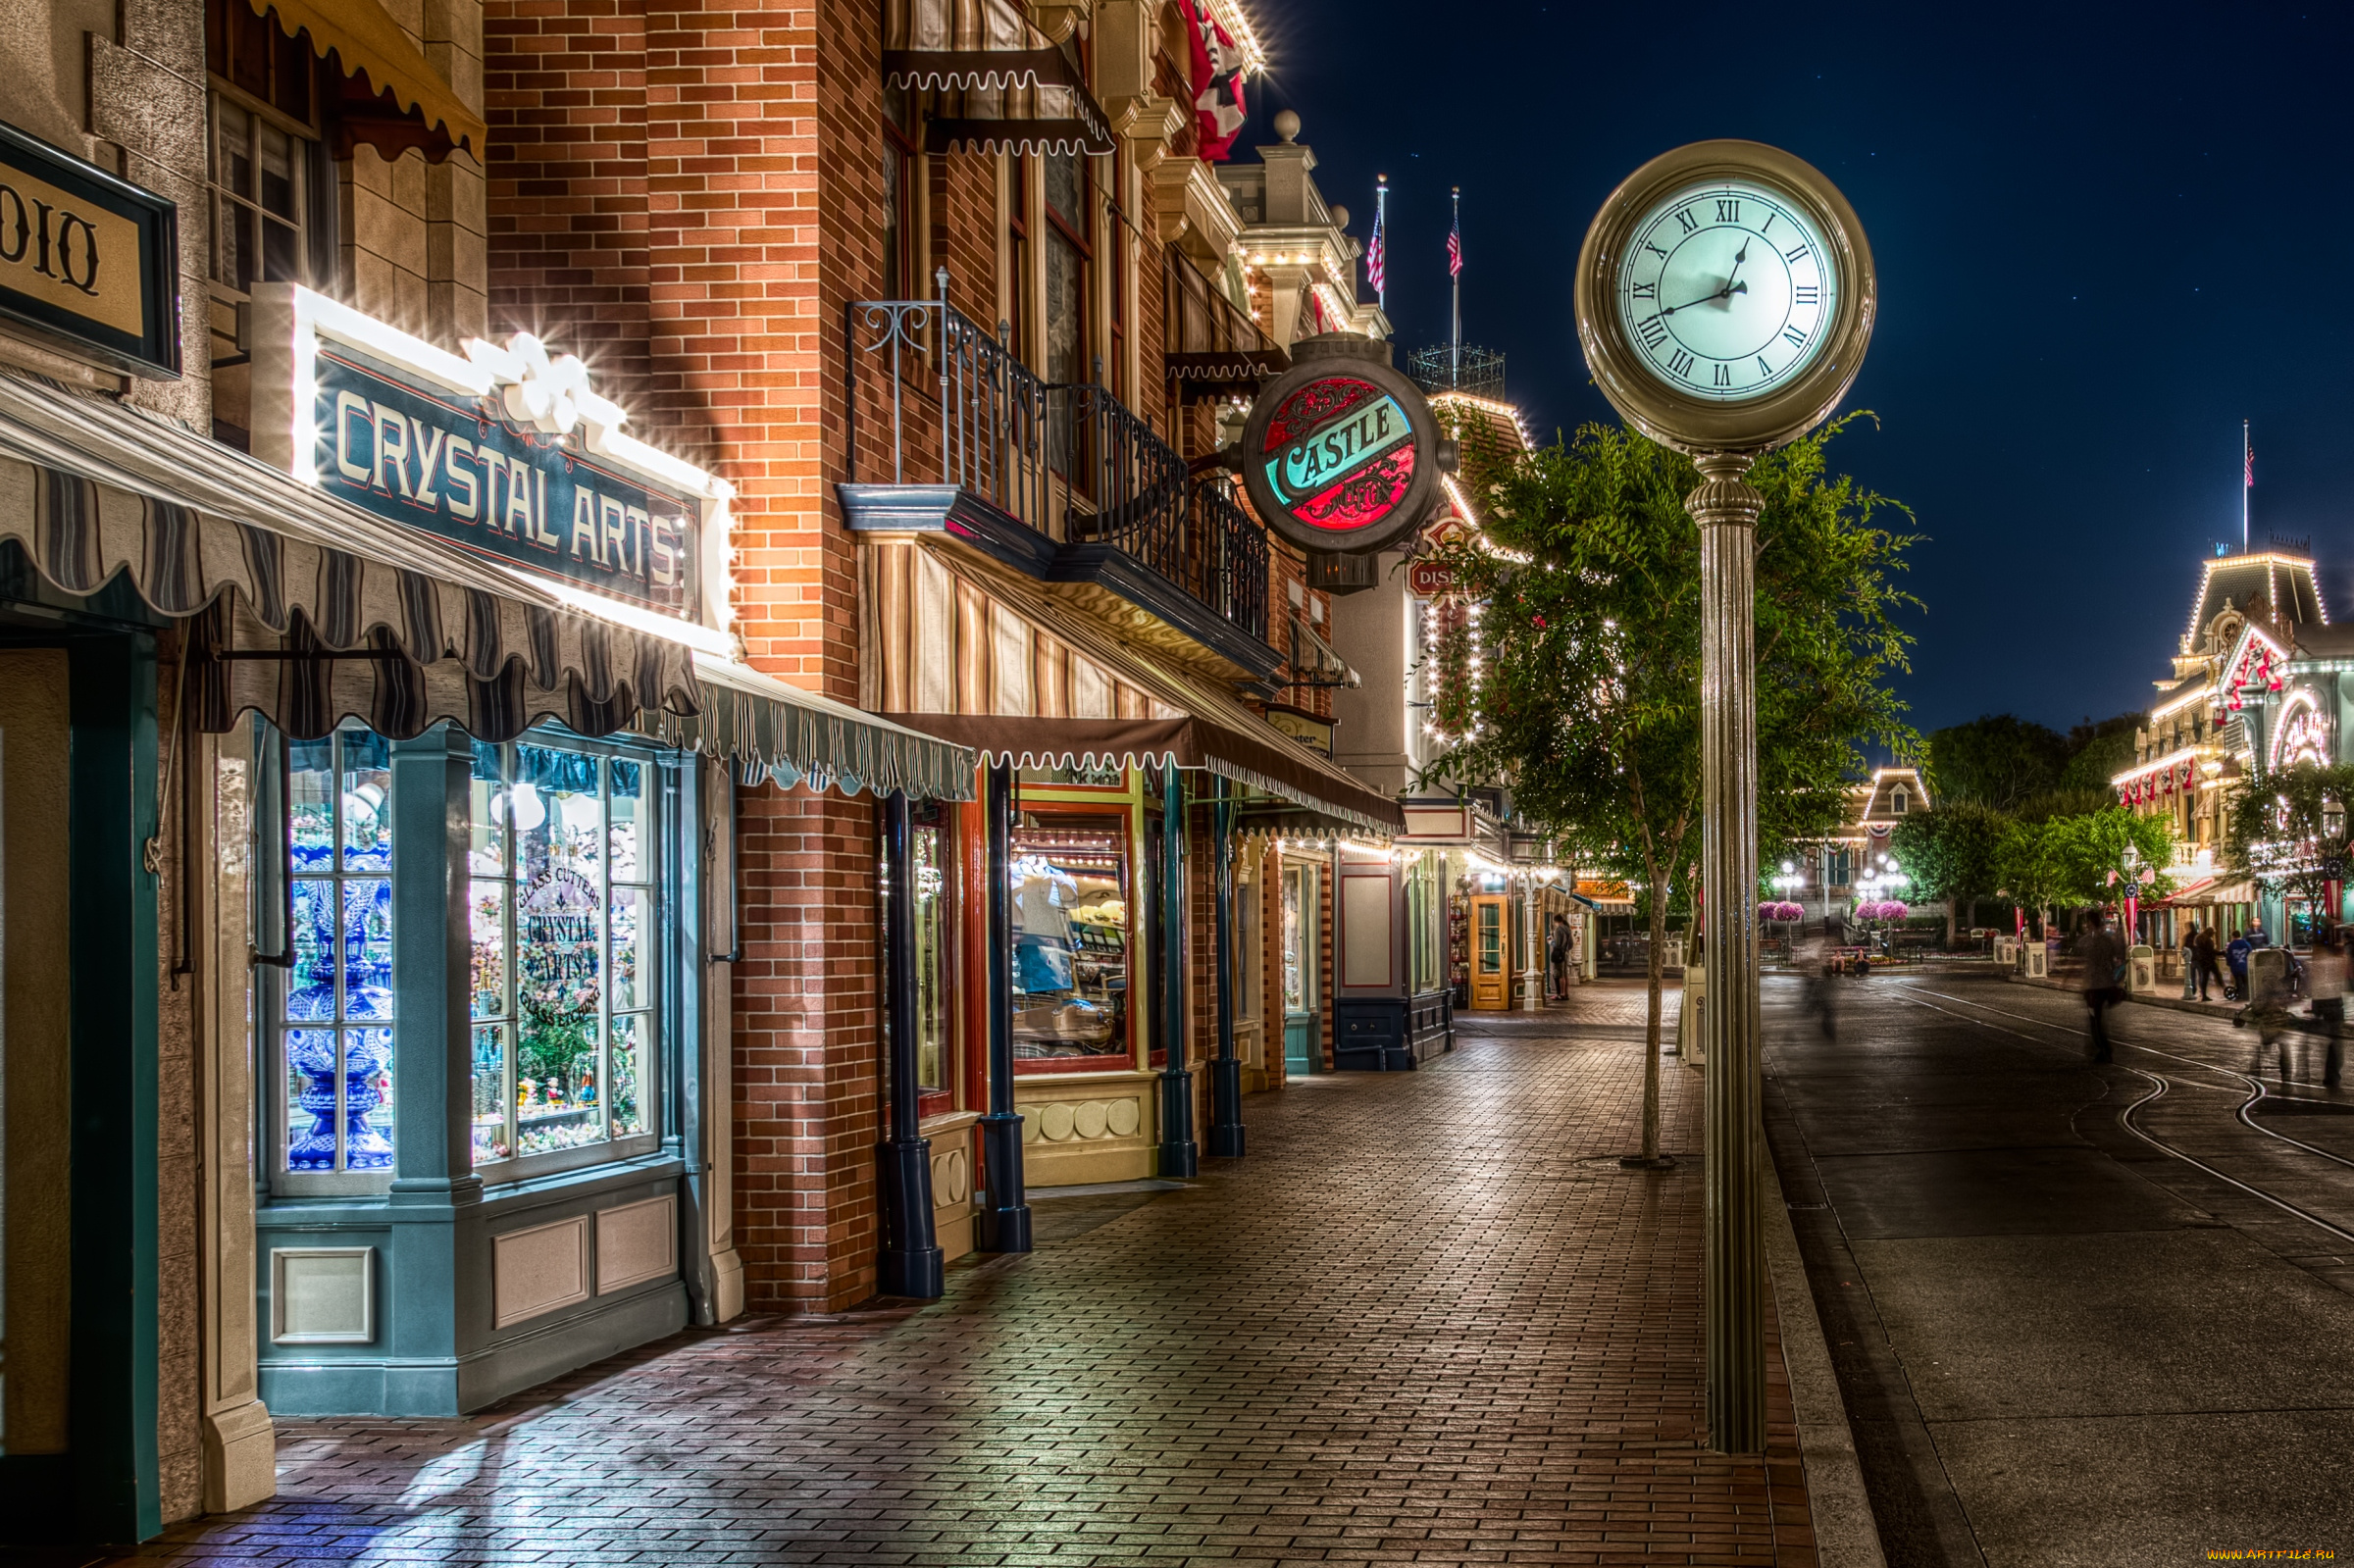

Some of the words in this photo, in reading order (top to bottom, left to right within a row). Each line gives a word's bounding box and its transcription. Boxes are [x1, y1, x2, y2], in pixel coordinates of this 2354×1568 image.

[1675, 208, 1699, 234] XI
[1715, 200, 1740, 223] XII
[1762, 213, 1776, 233] I
[1645, 240, 1667, 261] X
[1786, 243, 1810, 264] II
[1633, 281, 1655, 300] IX
[1796, 285, 1818, 305] III
[1637, 315, 1668, 351] VIII
[1783, 324, 1808, 349] IV
[1666, 347, 1696, 379] VII
[1714, 364, 1731, 386] VI
[1757, 355, 1773, 378] V
[1276, 402, 1390, 498] CASTLE
[337, 390, 560, 544] CRYSTAL
[570, 484, 675, 585] ARTS
[519, 870, 552, 909] GLASS
[556, 867, 601, 911] CUTTERS
[529, 915, 593, 942] CRYSTAL
[538, 952, 583, 981] ARTS
[520, 990, 554, 1027] GLASS
[557, 986, 601, 1028] ETCHING
